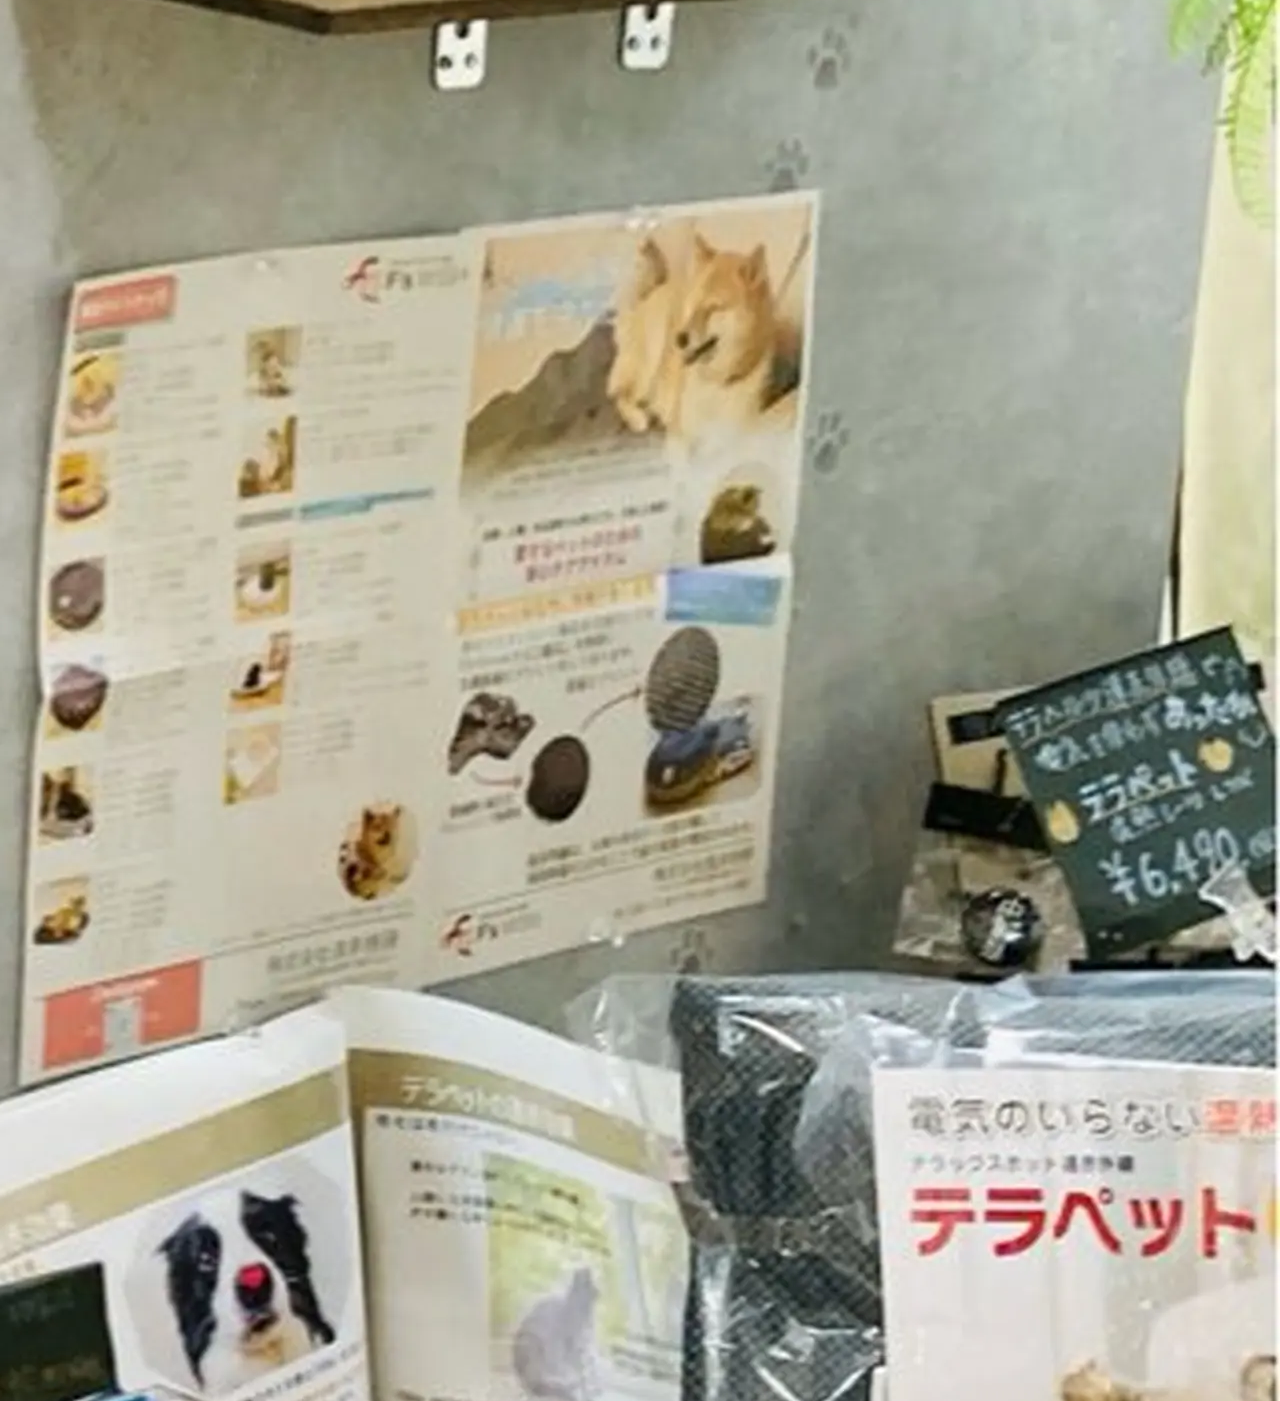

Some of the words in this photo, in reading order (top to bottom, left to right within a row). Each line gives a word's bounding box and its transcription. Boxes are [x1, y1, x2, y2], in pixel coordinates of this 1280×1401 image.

[910, 1186, 1257, 1259] テラペット
